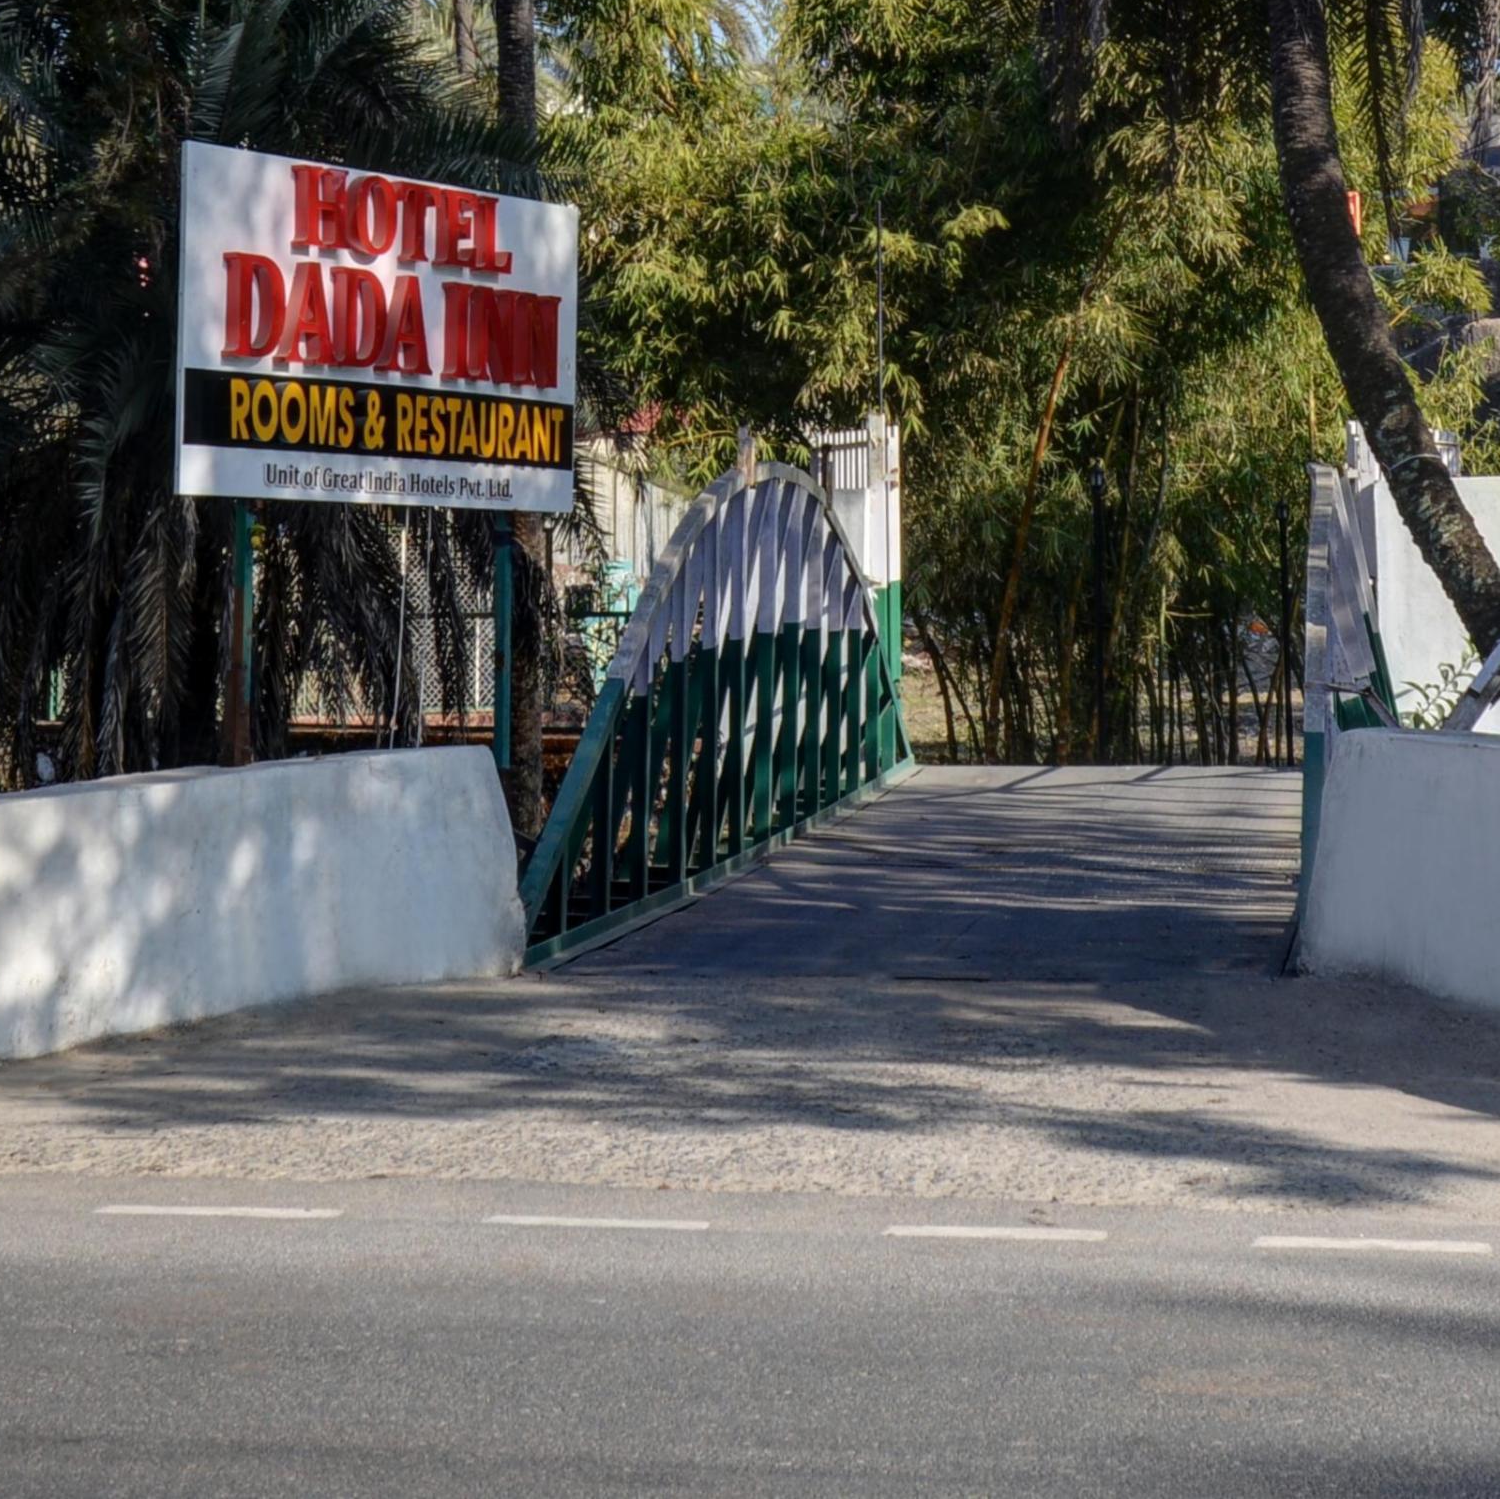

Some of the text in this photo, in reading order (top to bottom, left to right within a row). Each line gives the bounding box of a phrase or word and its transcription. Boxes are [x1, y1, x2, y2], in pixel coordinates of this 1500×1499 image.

[291, 164, 512, 274] HOTEL
[221, 252, 562, 389] DADA INN
[230, 378, 564, 463] ROOMS & RESTAURANT
[266, 463, 513, 499] Unit of Great India Hotels Pvt. Ltd.
